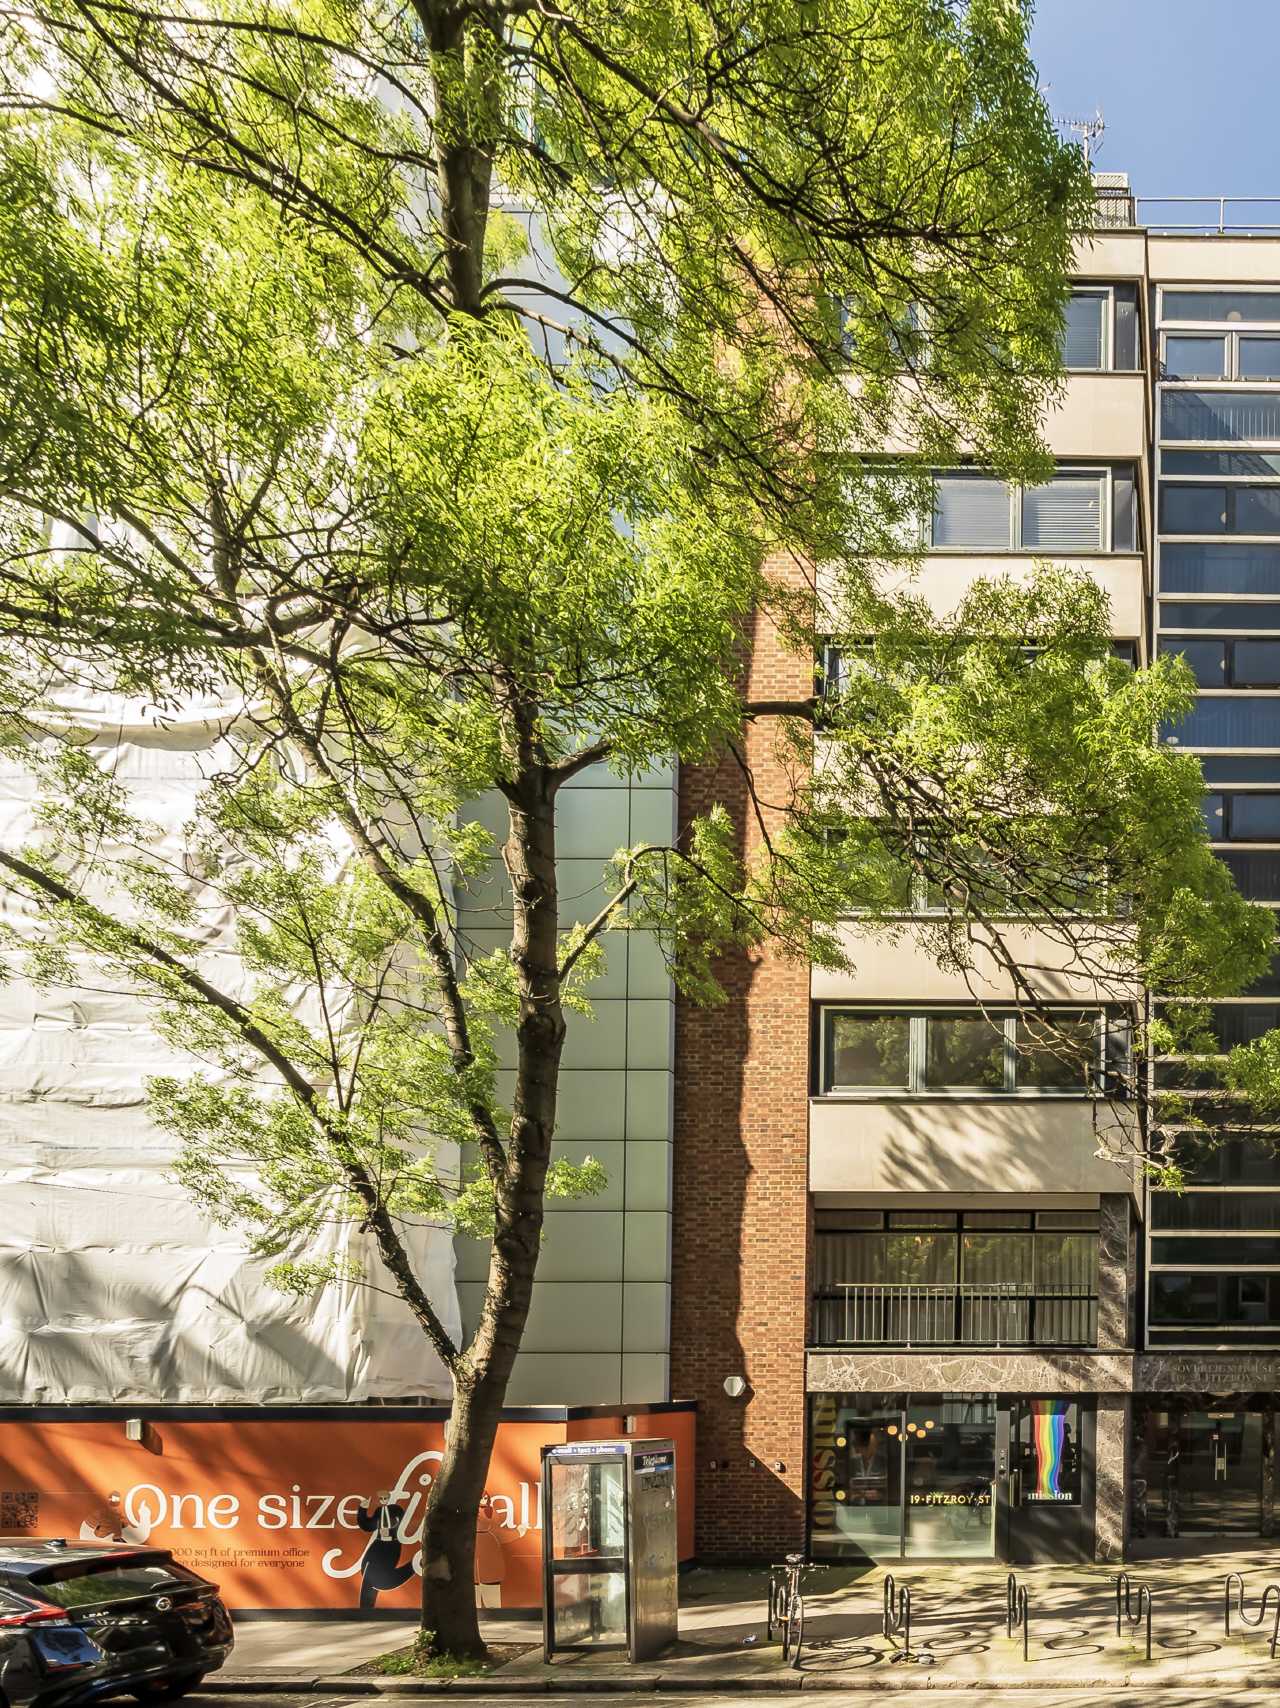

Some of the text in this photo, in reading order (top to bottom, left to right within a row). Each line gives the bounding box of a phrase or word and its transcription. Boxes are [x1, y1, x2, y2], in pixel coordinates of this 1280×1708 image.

[1028, 1490, 1072, 1500] mission
[124, 1484, 240, 1529] One
[257, 1484, 361, 1529] size
[233, 1548, 280, 1558] premium
[283, 1547, 310, 1557] office
[191, 1559, 237, 1569] designed
[240, 1559, 254, 1568] for
[257, 1560, 305, 1569] everyone
